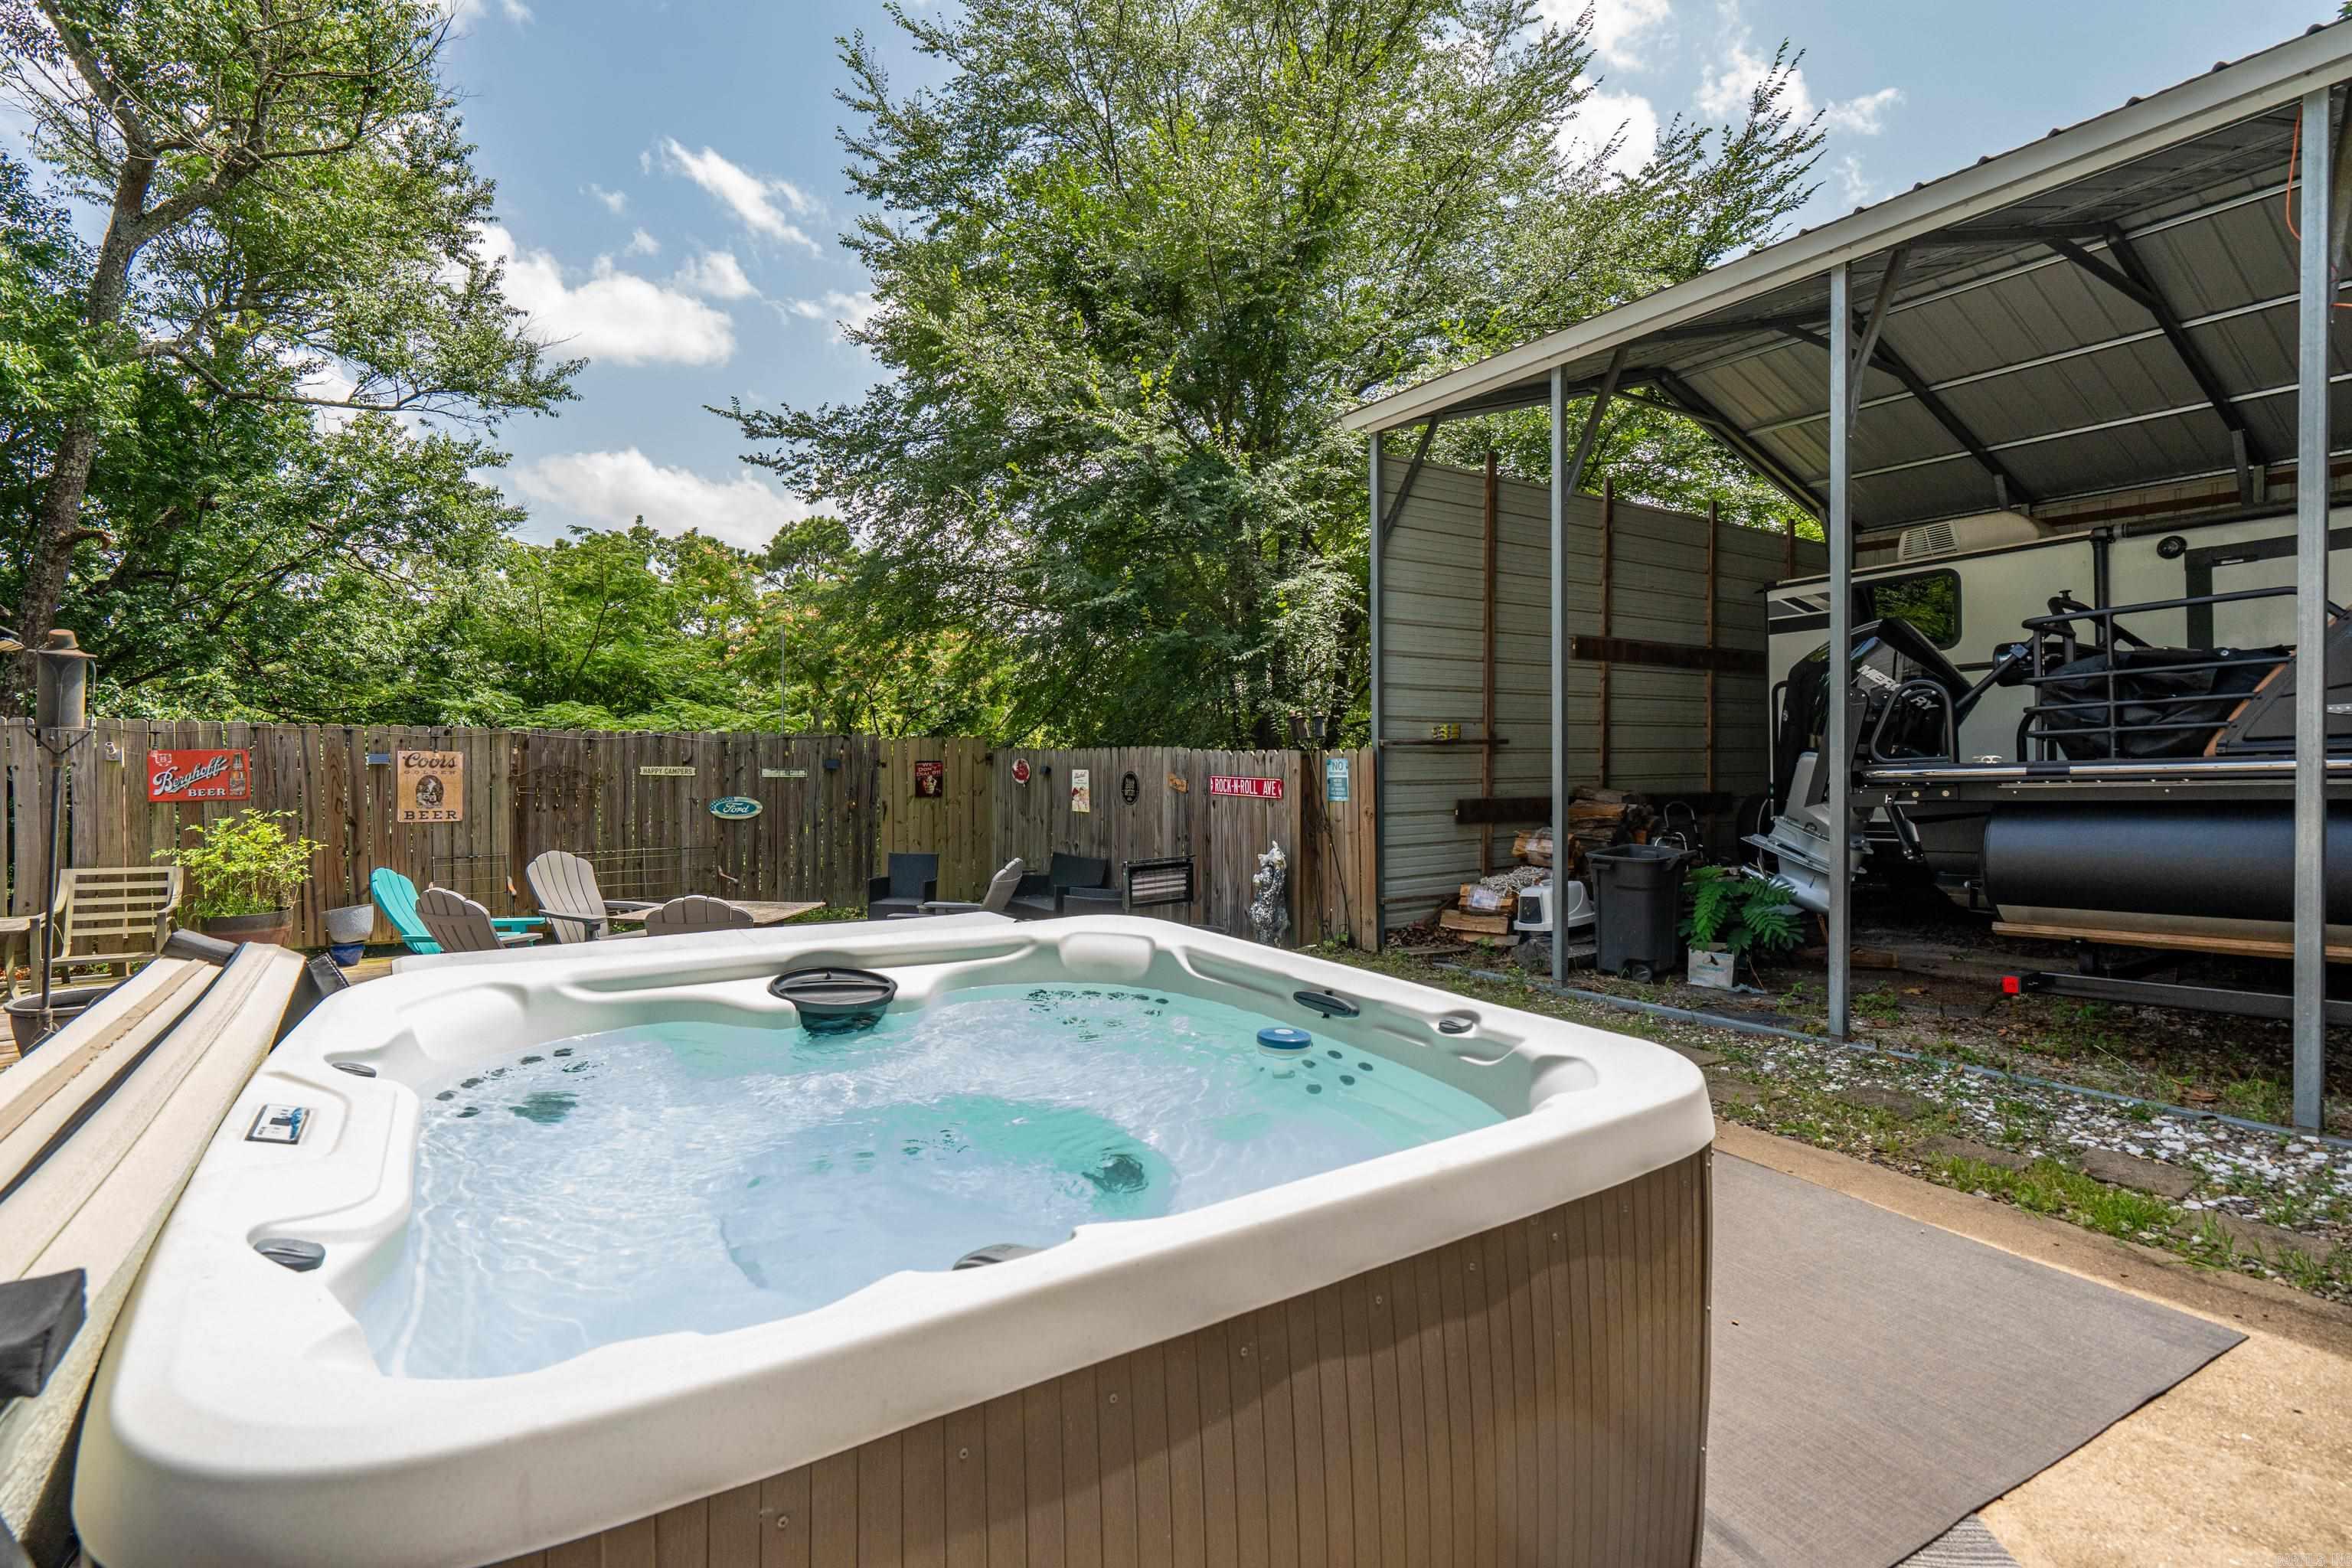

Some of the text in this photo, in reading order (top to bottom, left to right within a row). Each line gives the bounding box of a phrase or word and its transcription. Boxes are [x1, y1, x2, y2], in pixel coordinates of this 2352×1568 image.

[403, 753, 457, 769] Coors
[1332, 762, 1343, 771] NO
[153, 755, 228, 795] Berghoff
[188, 788, 226, 797] BEER
[1263, 780, 1276, 795] AVE
[723, 802, 750, 813] Ford
[404, 811, 457, 820] BEER
